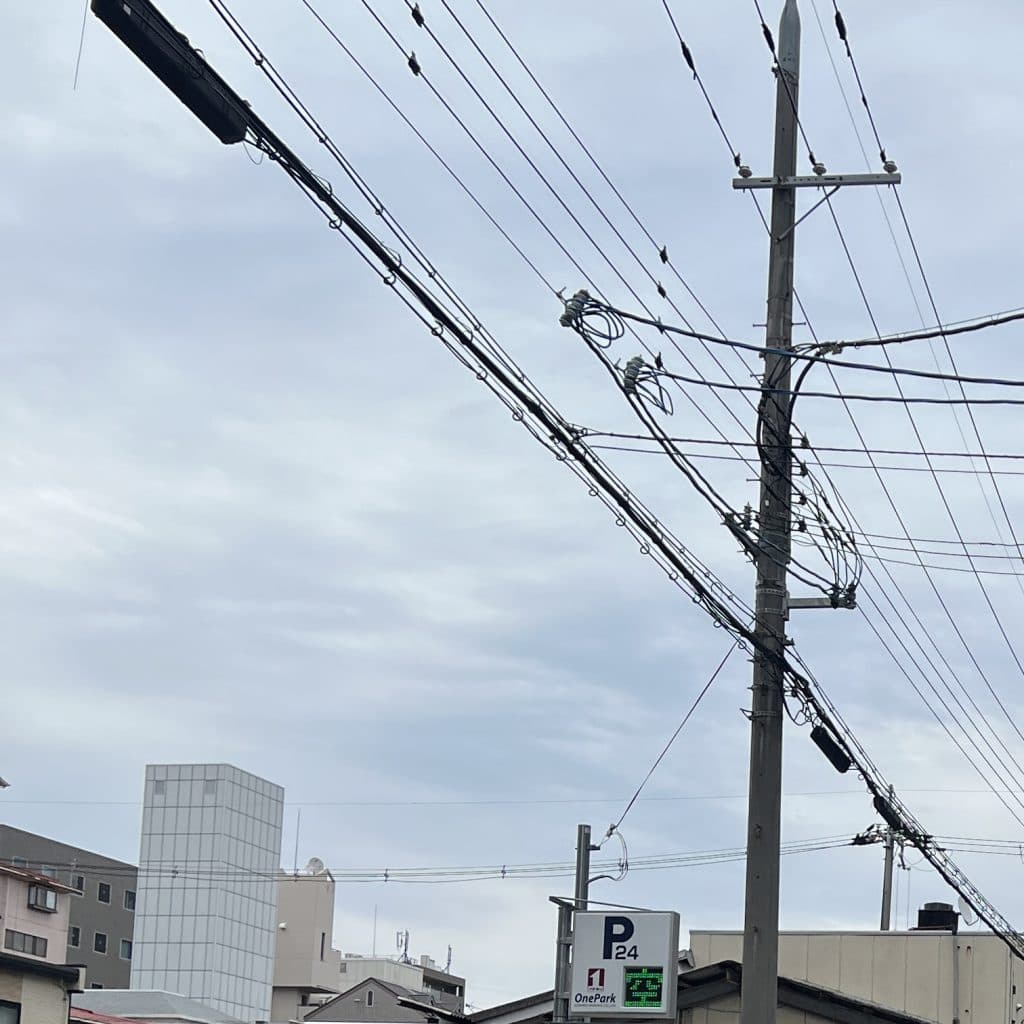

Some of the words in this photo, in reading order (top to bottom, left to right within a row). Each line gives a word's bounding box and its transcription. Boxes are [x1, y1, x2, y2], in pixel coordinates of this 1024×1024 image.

[603, 916, 634, 959] P
[615, 946, 639, 960] 24
[574, 992, 616, 1004] OnePark
